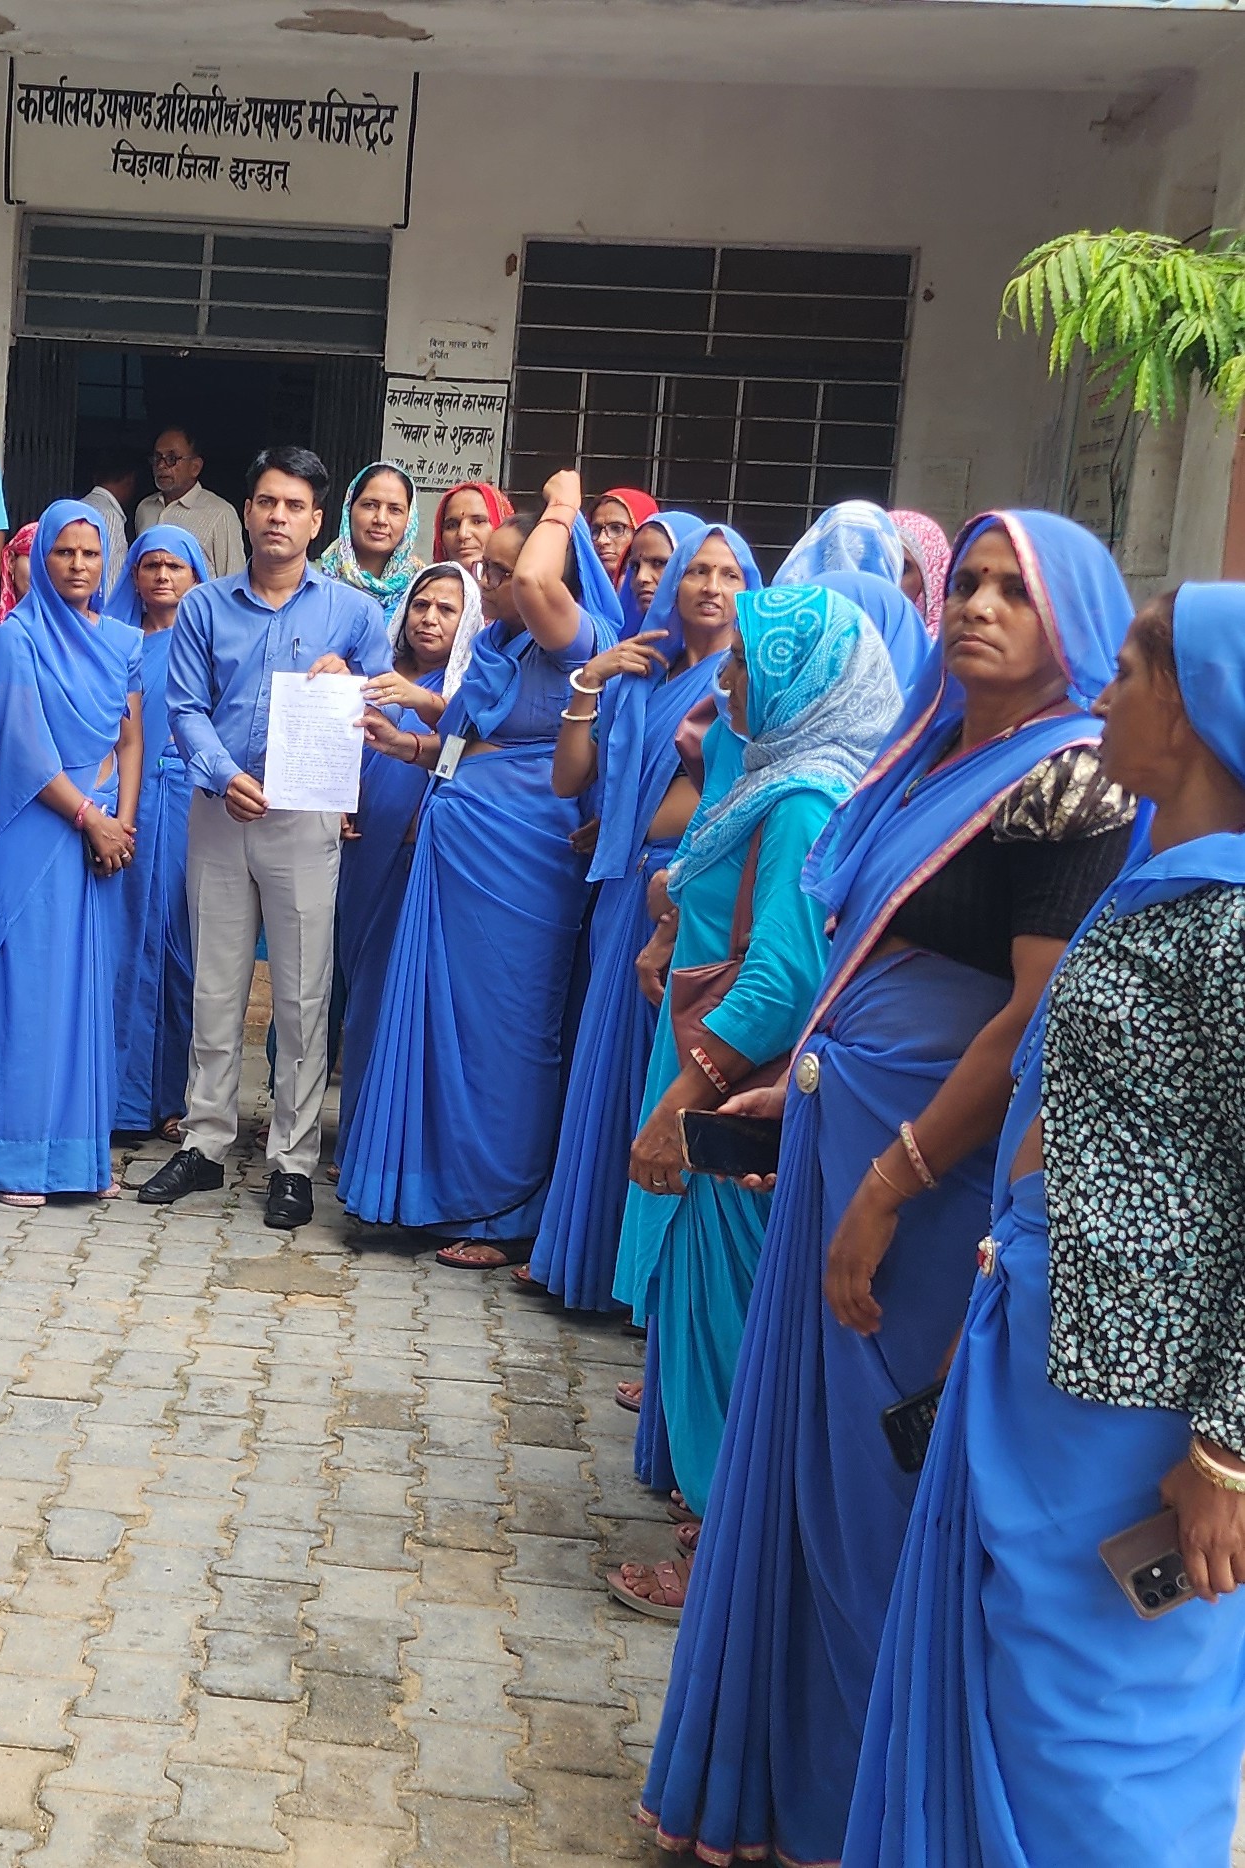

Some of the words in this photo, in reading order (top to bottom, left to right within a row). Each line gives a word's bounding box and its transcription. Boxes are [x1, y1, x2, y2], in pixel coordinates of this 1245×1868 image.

[17, 75, 97, 127] कार्यालय
[94, 88, 156, 131] उपखण्ड
[155, 82, 227, 139] अधिकारी
[240, 96, 306, 142] उपखण्ड
[307, 87, 399, 155] मजिस्ट्रेट
[387, 385, 435, 410] कार्यालय
[434, 385, 463, 417] खुलने
[462, 394, 478, 411] का
[477, 394, 506, 415] समय
[434, 418, 448, 446] से
[450, 425, 494, 457] शुक्रवार
[416, 454, 427, 475] से
[467, 462, 483, 480] तक
